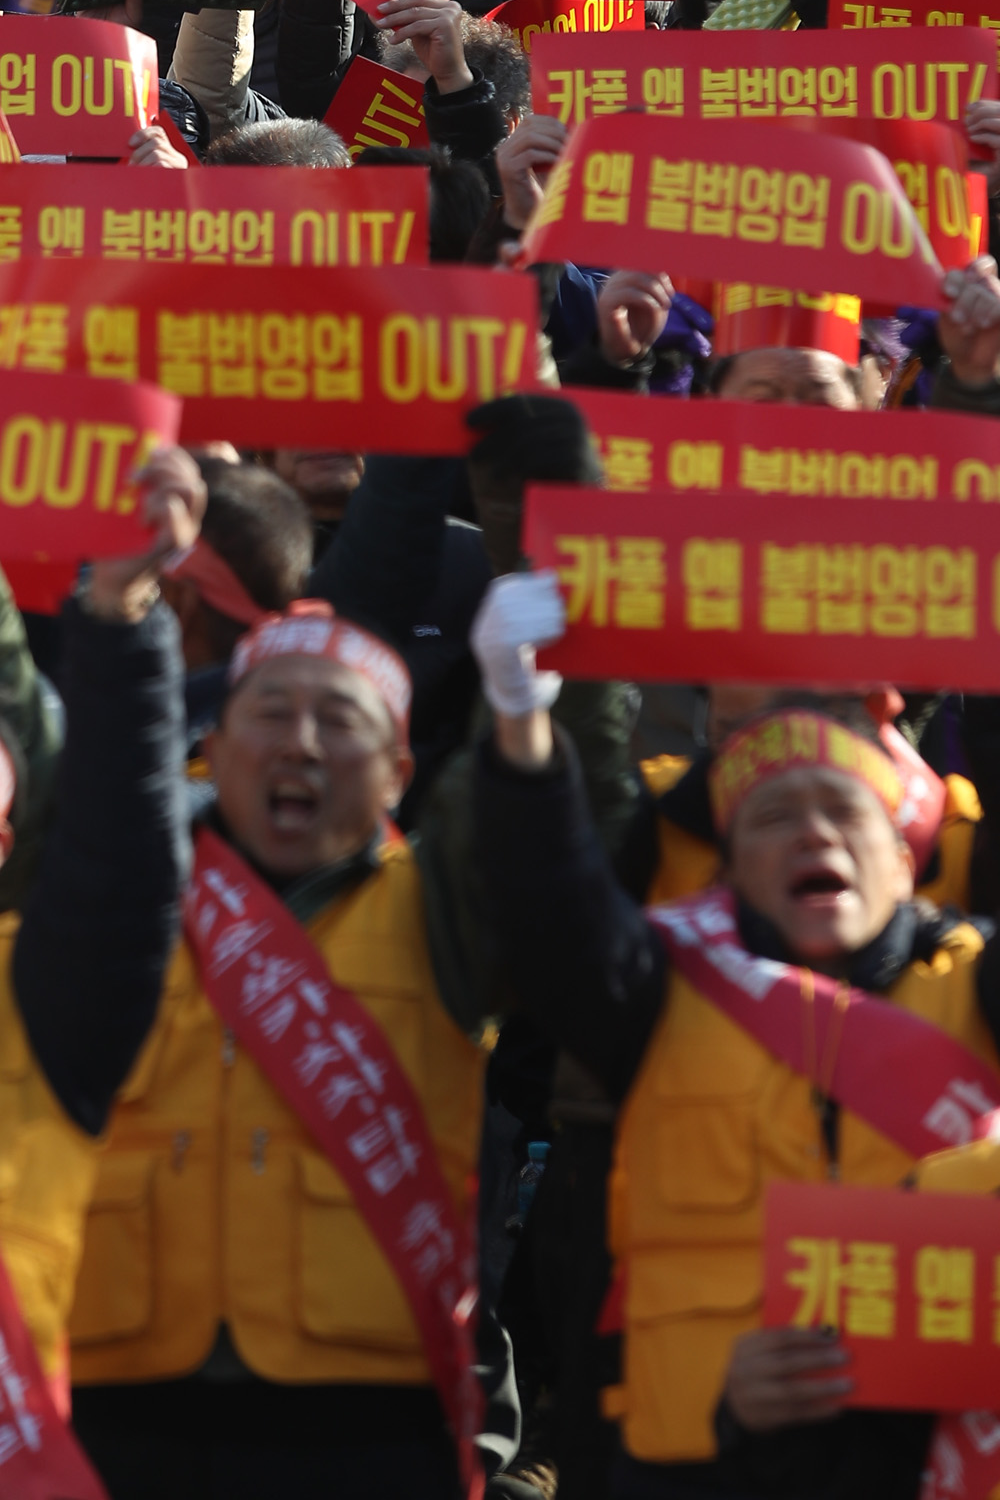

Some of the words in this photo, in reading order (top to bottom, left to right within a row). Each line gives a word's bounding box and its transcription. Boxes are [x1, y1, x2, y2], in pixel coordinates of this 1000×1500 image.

[51, 53, 151, 118] OUT!
[871, 62, 988, 121] OUT!
[583, 151, 634, 224] 앱
[646, 156, 831, 250] 불법영업
[157, 312, 361, 402] 불법영업
[379, 314, 527, 404] OUT!
[553, 535, 666, 629] 카풀
[682, 538, 744, 632] 앱
[760, 542, 978, 639] 불법영업
[784, 1235, 898, 1341] 카풀
[914, 1241, 977, 1344] 앱
